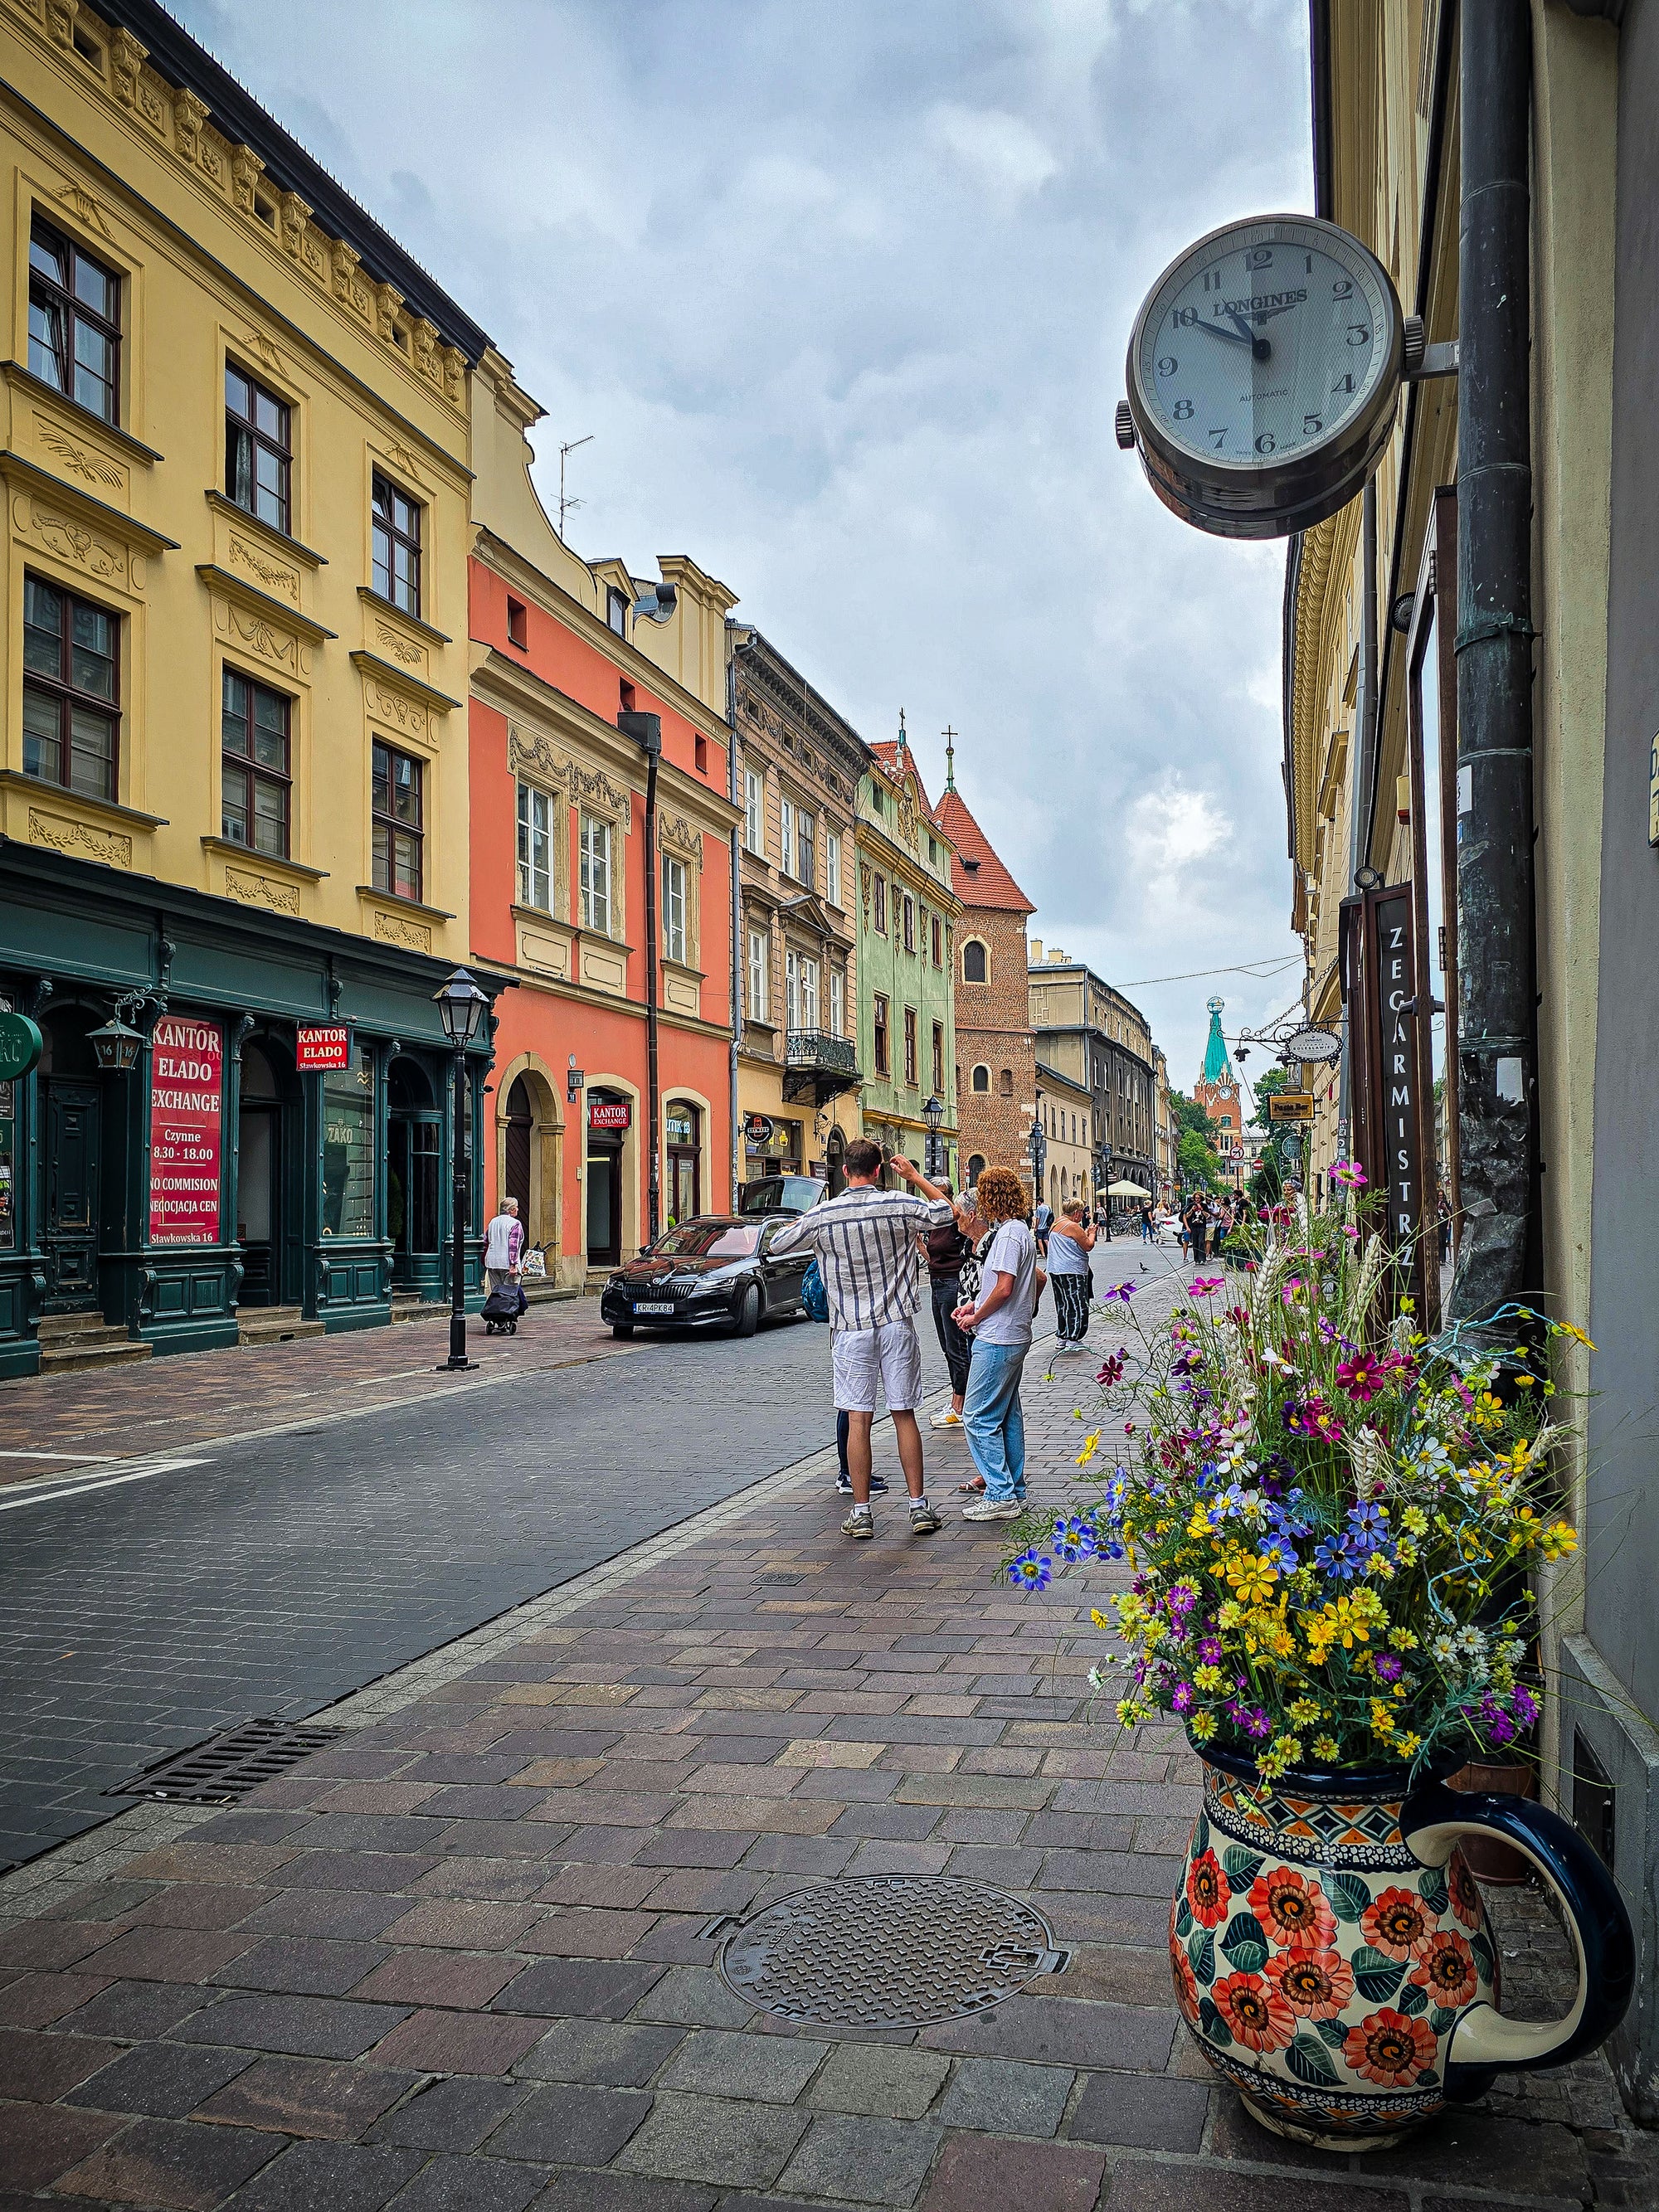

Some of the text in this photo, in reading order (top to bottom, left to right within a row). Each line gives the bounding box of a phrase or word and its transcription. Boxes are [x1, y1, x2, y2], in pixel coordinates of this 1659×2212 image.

[1243, 250, 1273, 272] 12
[1303, 253, 1313, 275] 1
[1201, 271, 1221, 291] 11
[1332, 280, 1354, 302] 2
[1213, 289, 1307, 317] LONGINES
[1171, 307, 1199, 329] 10
[1346, 323, 1369, 346] 3
[1158, 357, 1178, 377] 9
[1331, 373, 1356, 394] 4
[1239, 389, 1289, 403] AUTOMATIC
[1173, 400, 1194, 421] 8
[1302, 412, 1323, 435] 5
[1208, 427, 1228, 450] 7
[1254, 433, 1276, 455] 6
[153, 1022, 221, 1053] KANTOR
[298, 1028, 348, 1043] KANTOR
[101, 1044, 113, 1057] 16
[124, 1046, 134, 1057] 16
[304, 1046, 343, 1058] ELADO
[158, 1057, 212, 1082] ELADO
[151, 1089, 220, 1112] EXCHANGE
[1389, 926, 1414, 1266] ZEGARMISTRZ
[593, 1106, 627, 1118] KANTOR
[164, 1129, 202, 1144] Czynne
[153, 1146, 175, 1159] 8.30
[182, 1148, 213, 1160] 18.00
[150, 1177, 218, 1191] NO COMMISION
[199, 1200, 217, 1213] CEN
[151, 1232, 213, 1244] Sławkowska 16
